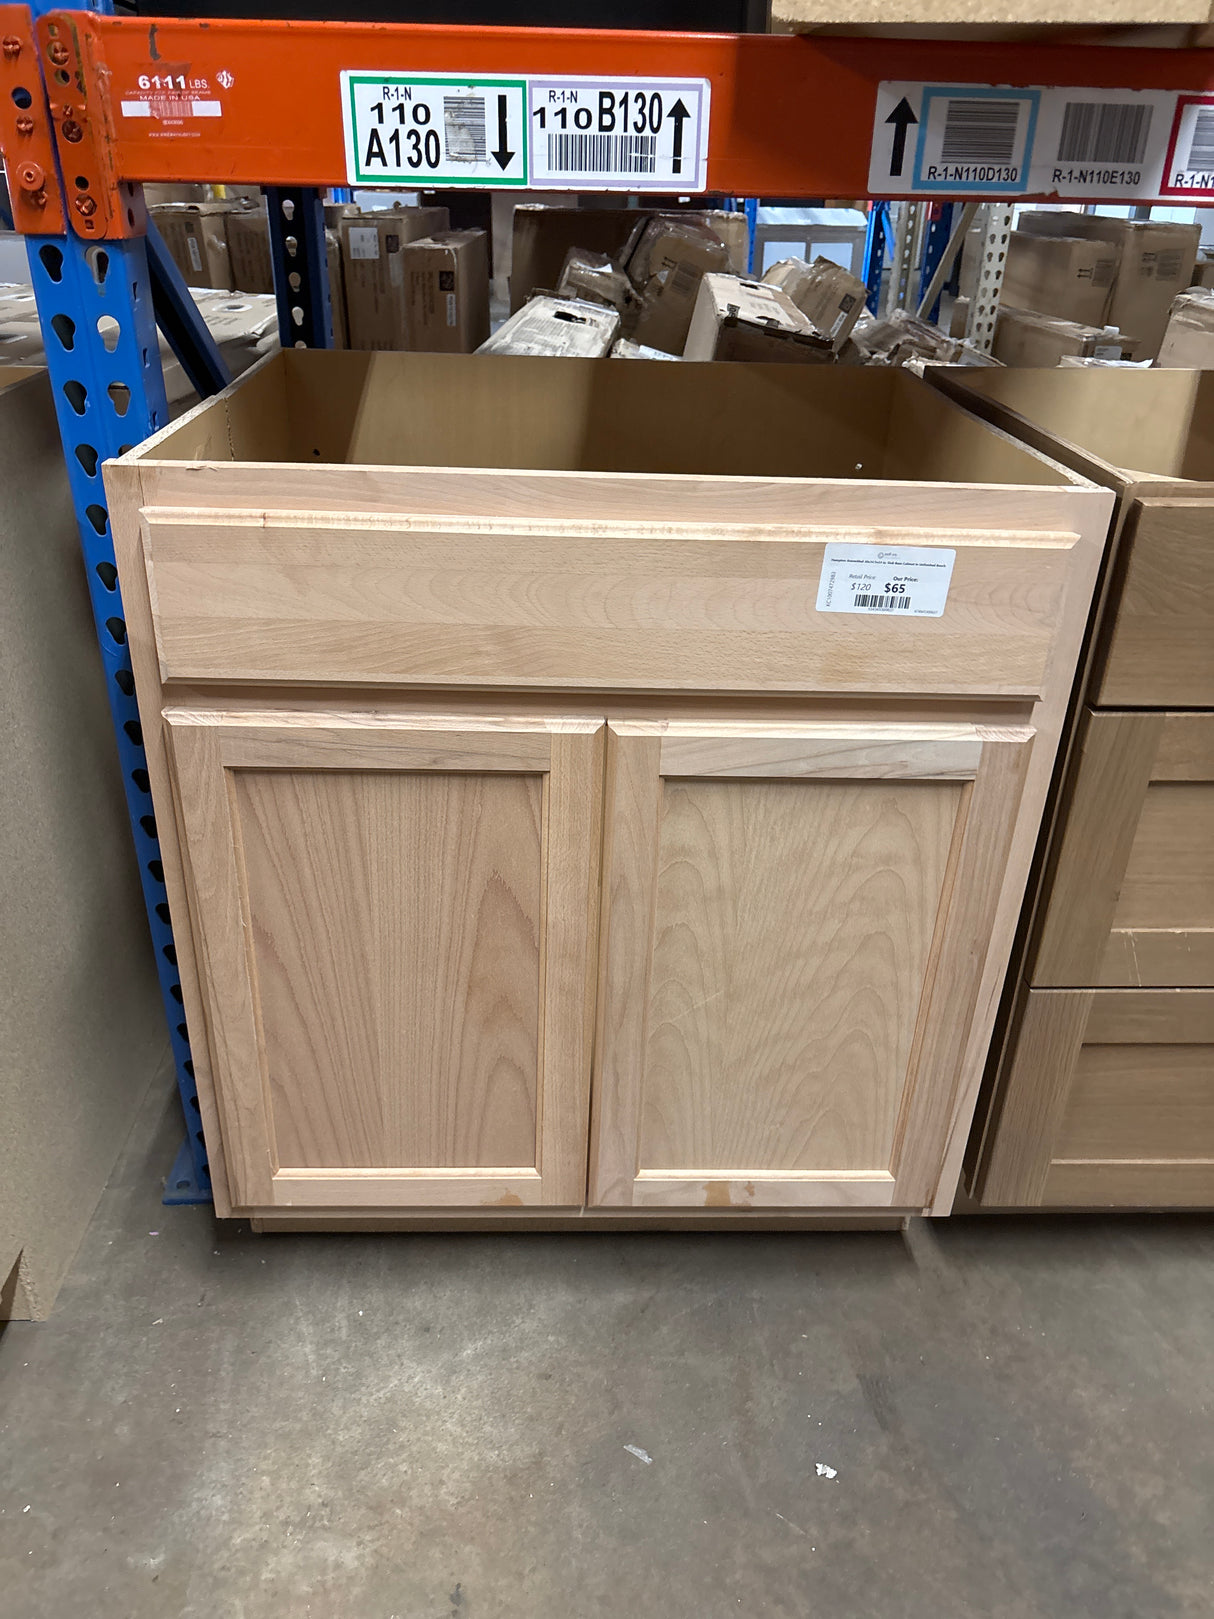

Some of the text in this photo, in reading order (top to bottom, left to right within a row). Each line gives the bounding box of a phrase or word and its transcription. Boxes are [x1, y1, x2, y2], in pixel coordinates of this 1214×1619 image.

[138, 75, 186, 89] 6111
[383, 86, 412, 101] R-1-N
[549, 90, 578, 104] R-1-N
[370, 103, 431, 125] 110
[365, 129, 440, 168] A130
[928, 165, 1018, 182] R-1-N110D130
[1052, 169, 1141, 185] R-1-N110E130
[851, 582, 871, 591] $120
[884, 582, 906, 594] $65
